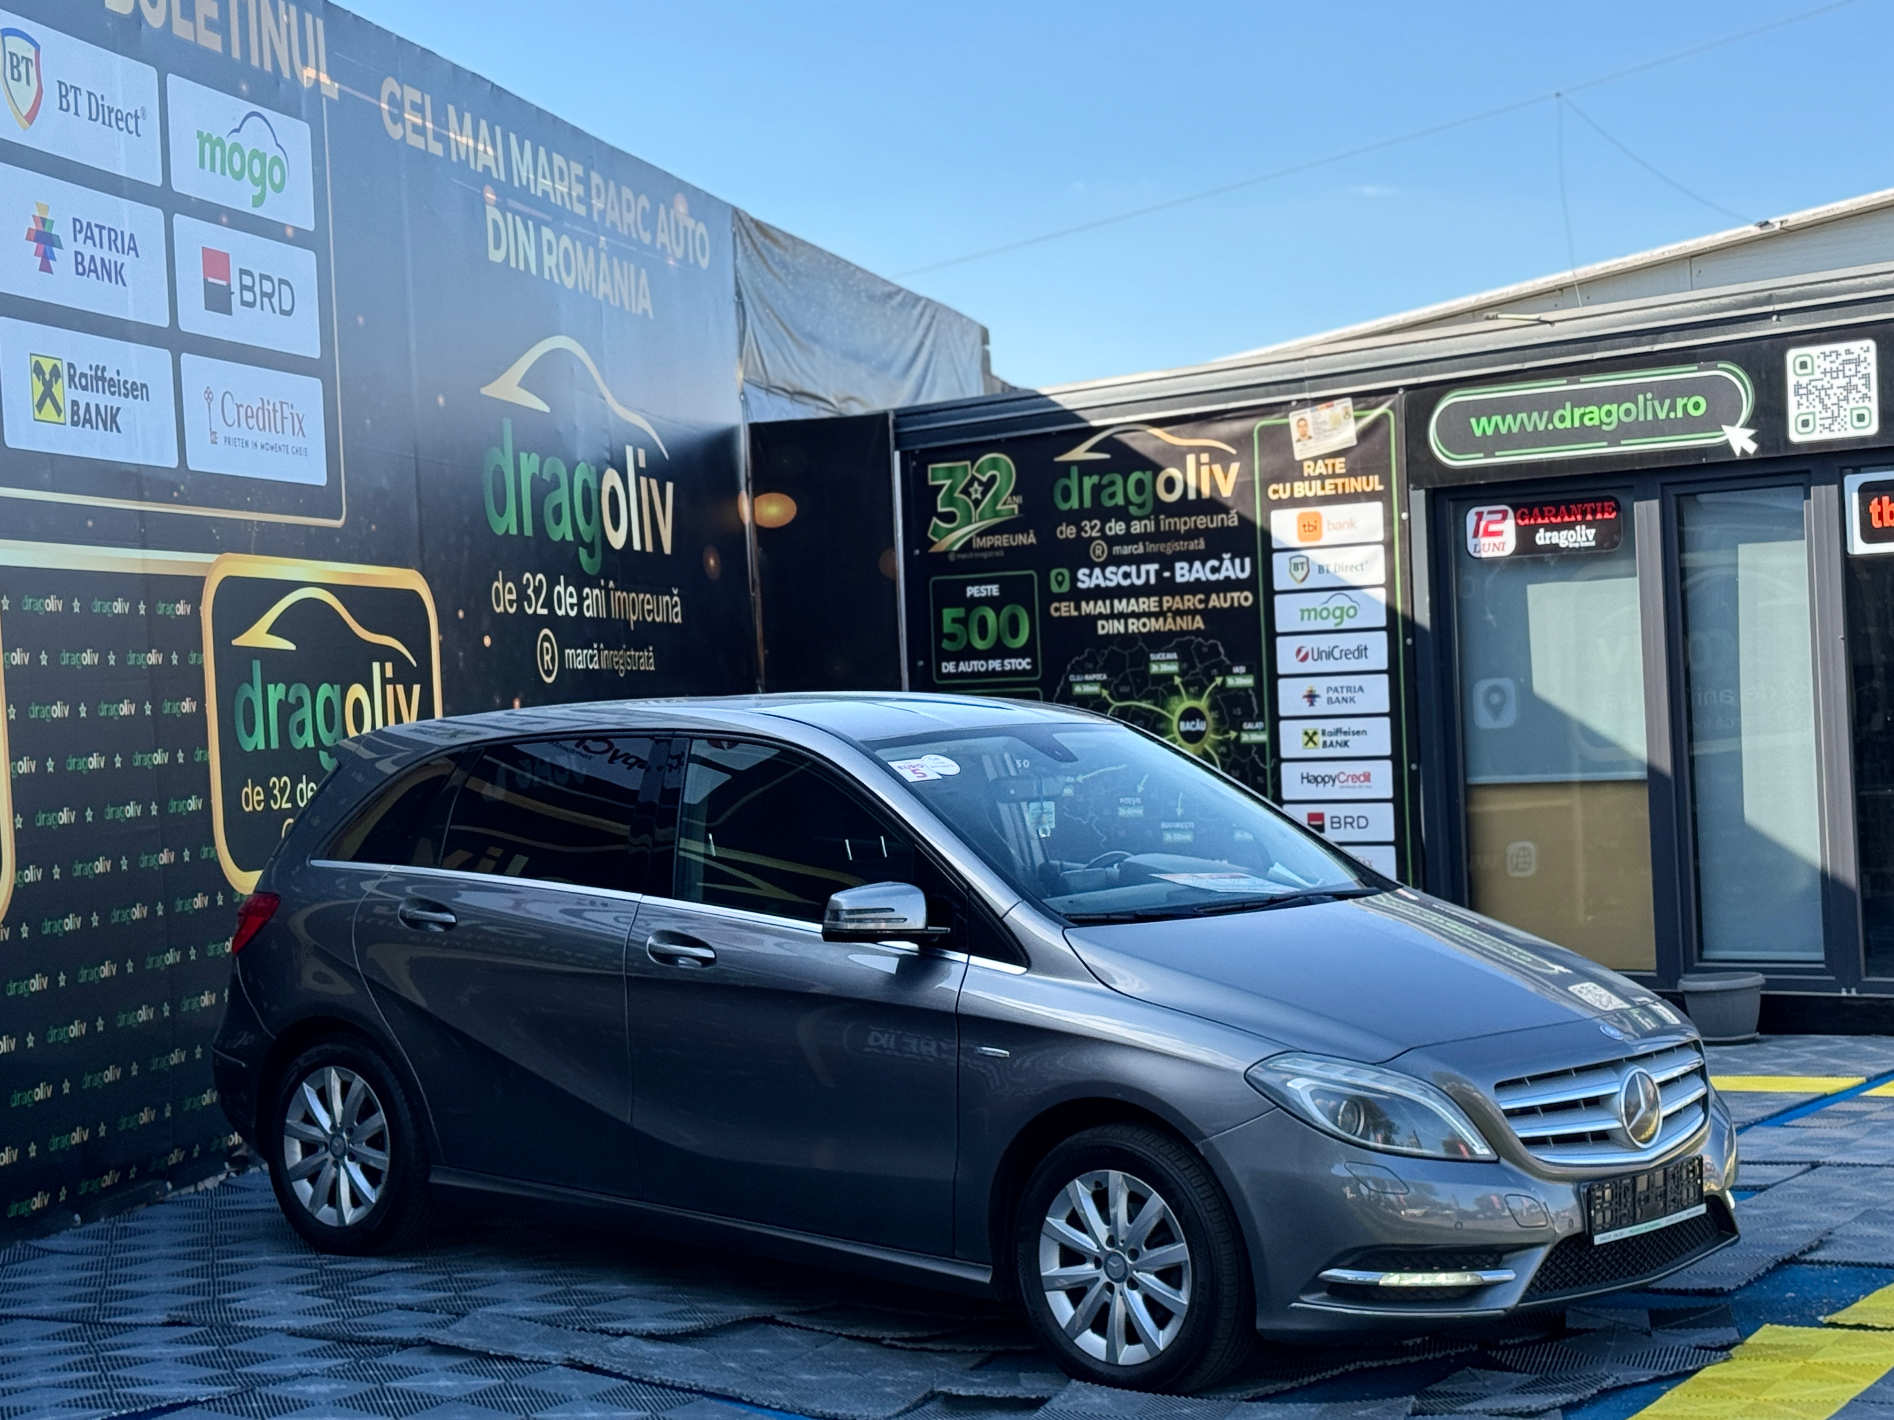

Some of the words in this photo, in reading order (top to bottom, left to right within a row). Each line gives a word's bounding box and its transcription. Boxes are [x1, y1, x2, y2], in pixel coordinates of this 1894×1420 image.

[105, 0, 338, 100] LETINUL
[8, 50, 34, 87] BT
[57, 80, 82, 117] BT
[196, 129, 286, 208] mogo
[381, 77, 443, 157] CEL
[448, 103, 506, 182] MAI
[510, 132, 586, 216] MARE
[591, 171, 651, 245] PARC
[656, 203, 710, 270] AUTO
[72, 217, 139, 258] PATRIA
[74, 250, 127, 287] BANK
[486, 205, 537, 275] DIN
[541, 225, 654, 320] ROMÂNIA
[238, 268, 295, 317] BRD
[67, 362, 149, 402] Raiffeisen
[70, 400, 122, 434] BANK
[221, 390, 306, 438] CreditFix
[1469, 392, 1708, 439] www.dragoliv.ro
[224, 435, 249, 448] PRIETEN
[260, 442, 289, 455] MOMENTE
[291, 446, 308, 457] CHEIE
[1303, 458, 1346, 477] RATE
[483, 417, 674, 575] dragoliv
[1053, 452, 1241, 516] dragoliv
[1268, 482, 1291, 500] CU
[1294, 475, 1384, 498] BULETINUL
[1056, 522, 1077, 540] de
[1080, 519, 1102, 537] 32
[1105, 516, 1126, 536] de
[1130, 515, 1155, 534] ani
[1159, 509, 1239, 534] împreună
[1302, 520, 1318, 534] tbi
[1327, 518, 1357, 532] bank
[1472, 509, 1508, 539] 12
[1516, 501, 1617, 526] GARANTIE
[972, 529, 1037, 549] ÎMPREUNĂ
[1112, 540, 1144, 556] marcă
[1473, 542, 1506, 554] LUNI
[1535, 525, 1596, 548] dragoliv
[1076, 563, 1159, 589] SASCUT
[1174, 553, 1251, 583] BACĂU
[1293, 562, 1306, 572] BT
[1318, 563, 1332, 574] BT
[492, 570, 517, 614] de
[523, 572, 549, 615] 32
[554, 575, 578, 617] de
[583, 579, 606, 619] ani
[610, 580, 682, 630] împreună
[966, 584, 1000, 598] PESTE
[1050, 601, 1079, 617] CEL
[1080, 598, 1111, 616] MAI
[1113, 595, 1160, 614] MARE
[1162, 593, 1206, 612] PARC
[1208, 591, 1253, 609] AUTO
[22, 595, 62, 615] dragoliv
[91, 597, 129, 617] dragoliv
[156, 600, 191, 618] dragoliv
[1299, 604, 1358, 627] mogo
[941, 603, 1030, 651] 500
[1097, 619, 1128, 635] DIN
[1127, 614, 1205, 634] ROMÂNIA
[4, 648, 29, 669] goliv
[60, 648, 98, 669] dragoliv
[127, 649, 162, 669] dragoliv
[565, 642, 600, 670] marcă
[600, 643, 655, 677] înregistrată
[941, 661, 956, 673] DE
[958, 660, 987, 672] AUTO
[988, 660, 1002, 671] PE
[1004, 658, 1032, 670] STOC
[1149, 652, 1178, 661] SUCEAVA
[1311, 644, 1368, 662] UniCredit
[1326, 685, 1365, 695] PATRIA
[1326, 696, 1356, 705] BANK
[28, 701, 69, 722] dragoliv
[98, 699, 135, 720] dragoliv
[162, 697, 196, 717] dragoliv
[234, 659, 421, 771] dragoliv
[1179, 718, 1207, 732] BACĂU
[1321, 727, 1368, 738] Raiffeisen
[1322, 739, 1350, 749] BANK
[11, 756, 36, 778] goliv
[66, 753, 105, 773] dragoliv
[133, 748, 169, 769] dragoliv
[242, 779, 264, 812] de
[270, 776, 292, 810] 32
[1301, 771, 1371, 788] HappyCredit
[36, 807, 76, 829] dragoliv
[104, 801, 142, 822] dragoliv
[168, 795, 203, 815] dragoliv
[1330, 815, 1369, 830] BRD
[14, 865, 42, 887] goliv
[72, 856, 111, 878] dragoliv
[139, 848, 174, 869] dragoliv
[41, 913, 81, 936] dragoliv
[111, 903, 148, 924] dragoliv
[174, 892, 209, 914] dragoliv
[6, 973, 48, 997] dragoliv
[78, 960, 117, 983] dragoliv
[145, 948, 181, 970] dragoliv
[47, 1020, 87, 1043] dragoliv
[116, 1005, 154, 1028] dragoliv
[181, 991, 216, 1012] dragoliv
[10, 1082, 52, 1107] dragoliv
[82, 1065, 121, 1089] dragoliv
[150, 1048, 186, 1070] dragoliv
[50, 1126, 89, 1151] dragoliv
[118, 1107, 156, 1131] dragoliv
[182, 1089, 218, 1112] dragoliv
